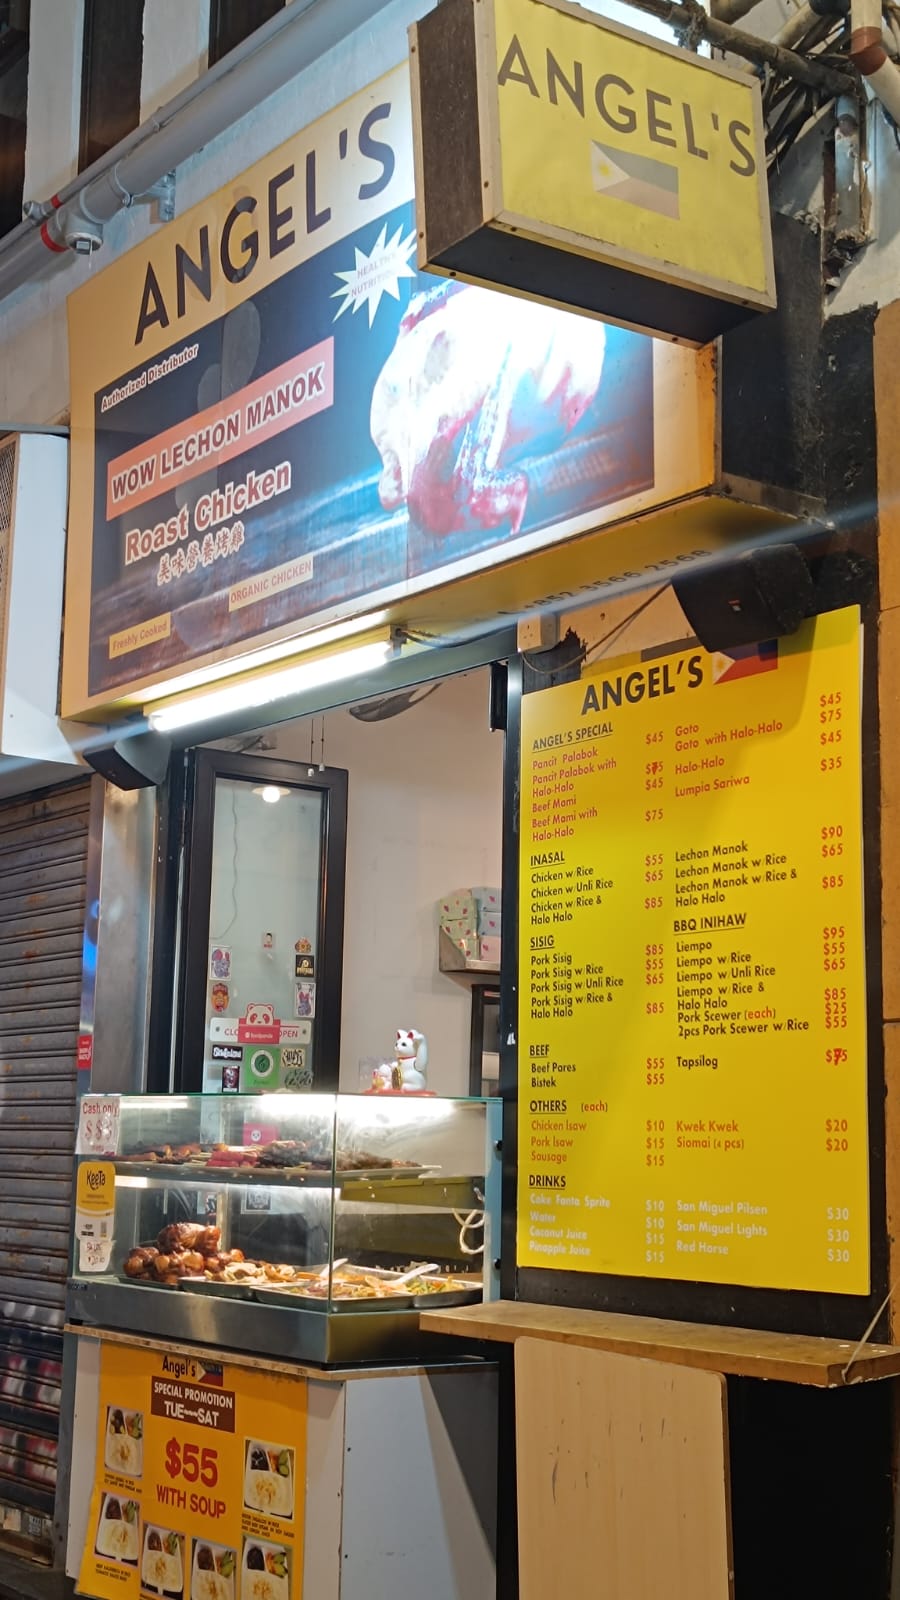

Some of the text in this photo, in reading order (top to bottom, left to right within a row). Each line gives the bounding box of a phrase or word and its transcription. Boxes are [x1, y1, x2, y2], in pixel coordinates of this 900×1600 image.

[498, 34, 756, 177] ANGEL'S
[134, 102, 394, 346] ANGEL'S
[101, 344, 198, 412] Authorized Distributor
[112, 362, 325, 502] WOW LECHON MANOK
[125, 461, 292, 566] Roast Chicken
[230, 560, 312, 603] ORGANIC CHICKEN
[112, 622, 168, 650] Freshly Cooked
[580, 656, 704, 716] ANGEL'S
[820, 692, 842, 708] $45
[820, 708, 842, 724] $75
[533, 722, 614, 750] ANGEL'S SPECIAL
[675, 724, 700, 736] Goto
[675, 720, 782, 752] Goto with Halo-Halo
[646, 732, 664, 745] $45
[820, 730, 842, 746] $45
[533, 746, 598, 770] Pancit Palabok
[820, 756, 842, 772] $35
[533, 758, 616, 785] Pancit Palabok with
[675, 756, 724, 775] Halo-Halo
[532, 781, 574, 798] Halo-Halo
[646, 777, 664, 791] $45
[675, 775, 750, 797] Lumpia Sariwa
[532, 794, 576, 813] Beef Mami
[532, 806, 598, 828] Beef Mami with
[646, 808, 664, 822] $75
[532, 826, 574, 842] Halo-Halo
[822, 826, 842, 840] $90
[675, 840, 748, 862] Lechon Manok
[822, 843, 843, 858] $65
[530, 851, 564, 866] INASAL
[645, 854, 664, 867] $55
[675, 858, 748, 878] Lechon Manok
[531, 872, 562, 884] Chicken
[645, 870, 664, 883] $65
[822, 874, 844, 890] $85
[531, 879, 614, 899] Chicken Rice
[675, 874, 748, 894] Lechon Manok
[644, 896, 663, 910] $85
[676, 891, 726, 908] Halo Halo
[531, 900, 562, 914] Chicken
[531, 911, 572, 926] Halo Halo
[674, 913, 746, 932] BBQ INIHAW
[823, 926, 844, 940] $95
[530, 935, 554, 948] SISIG
[676, 941, 712, 954] Liempo
[645, 944, 664, 956] $85
[824, 942, 845, 956] $55
[531, 954, 572, 966] Pork Sisig
[646, 958, 664, 971] $55
[676, 956, 712, 969] Liempo
[824, 958, 845, 972] $65
[531, 967, 572, 980] Pork Sisig
[646, 972, 664, 986] $65
[676, 965, 776, 984] Liempo Rice
[531, 976, 624, 993] Pork Sisig Rice
[676, 986, 712, 999] Liempo
[824, 988, 846, 1001] $85
[532, 994, 572, 1008] Pork Sisig
[646, 1002, 664, 1014] $85
[678, 997, 728, 1010] Halo Halo
[531, 1006, 572, 1019] Halo Halo
[678, 1006, 776, 1023] Pork Scewer (each)
[824, 1002, 847, 1016] $25
[825, 1016, 847, 1030] $55
[678, 1022, 768, 1039] 2pcs Pork Scewer
[530, 1044, 550, 1056] BEEF
[532, 1062, 576, 1073] Beef Pares
[646, 1058, 664, 1070] $55
[676, 1055, 718, 1070] Tapsilog
[532, 1076, 556, 1088] Bistek
[646, 1073, 664, 1085] $55
[82, 1102, 119, 1118] Cash only
[530, 1100, 608, 1112] OTHERS (each)
[532, 1120, 586, 1131] Chicken Isaw
[646, 1120, 664, 1132] $10
[676, 1120, 738, 1132] Kwek Kwek
[826, 1119, 848, 1132] $20
[531, 1136, 574, 1147] Pork Isaw
[646, 1138, 664, 1149] $15
[676, 1136, 710, 1148] Siomai
[826, 1138, 848, 1152] $20
[532, 1152, 567, 1164] Sausage
[646, 1155, 664, 1166] $15
[87, 1170, 106, 1188] KeeTa
[528, 1174, 566, 1188] DRINKS
[584, 1196, 611, 1210] Sprite
[676, 1200, 768, 1216] San Miguel Pilsen
[530, 1211, 556, 1223] Water
[676, 1220, 768, 1238] San Miguel Lights
[676, 1240, 728, 1255] Red Horse
[162, 1356, 196, 1378] Angel's
[154, 1382, 233, 1408] SPECIAL PROMOTION
[165, 1437, 218, 1488] $55
[156, 1484, 226, 1520] WITH SOUP
